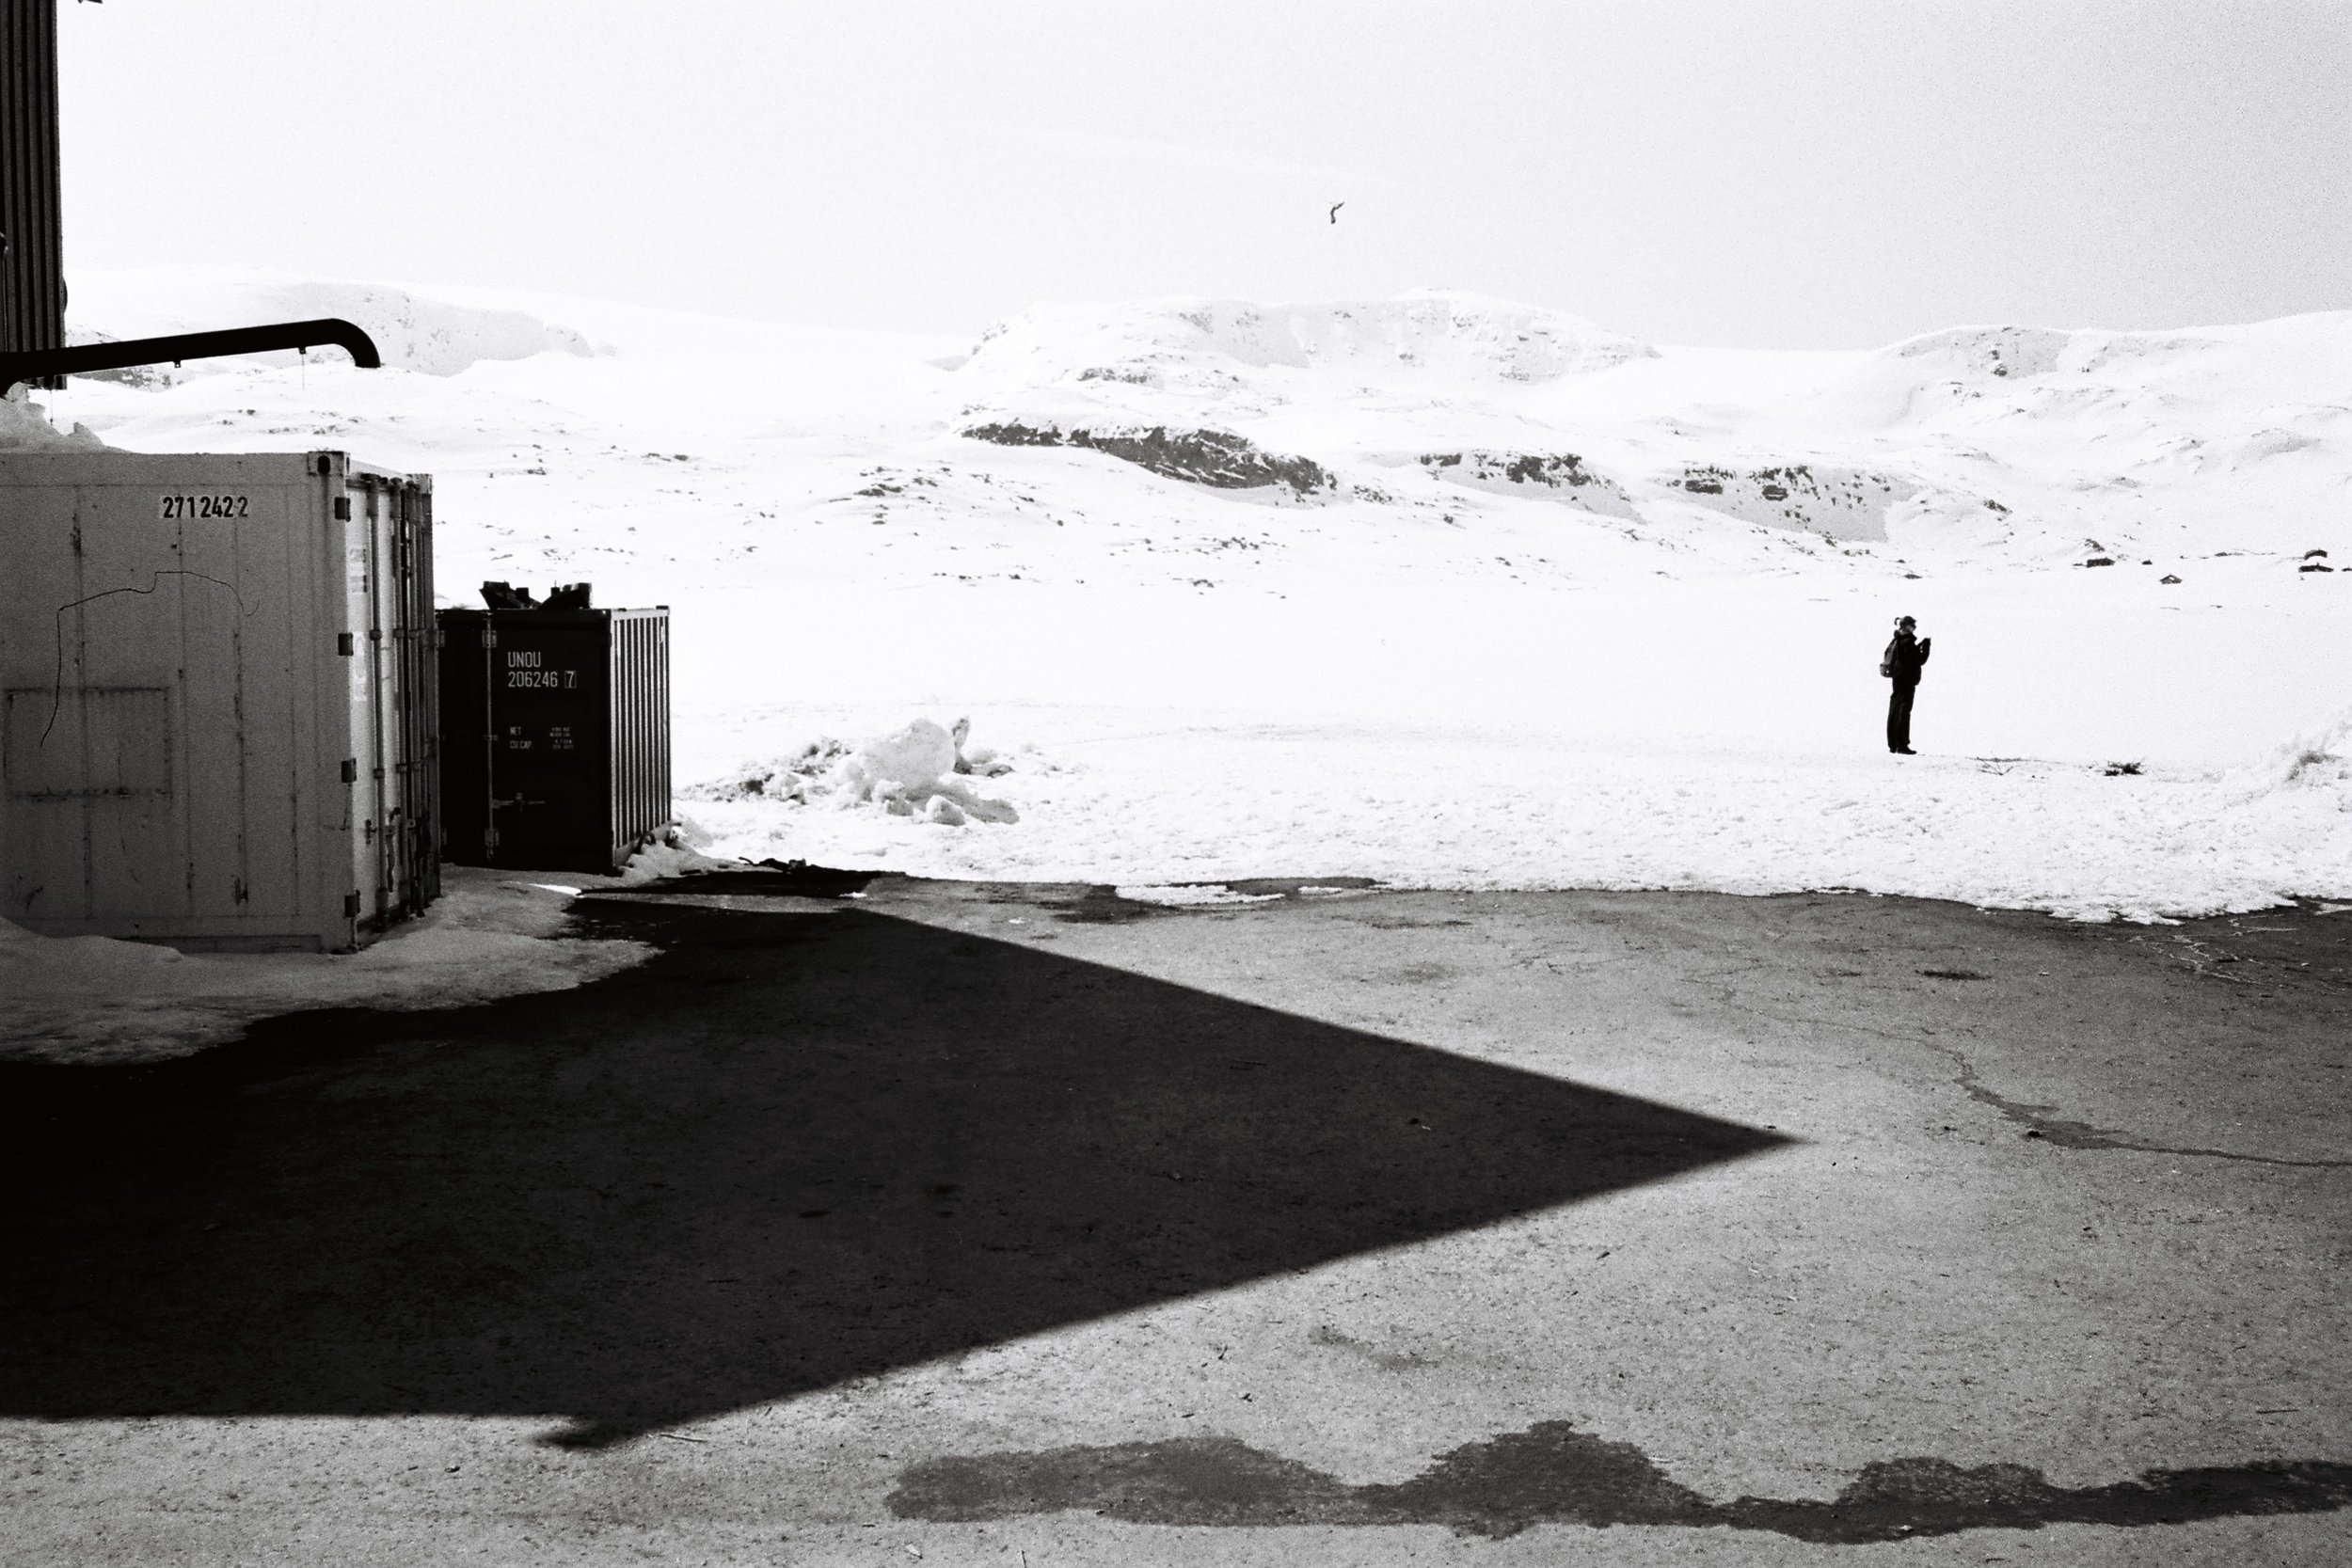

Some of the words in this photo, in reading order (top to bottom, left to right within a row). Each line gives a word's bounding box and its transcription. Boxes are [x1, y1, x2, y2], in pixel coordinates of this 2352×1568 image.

[507, 651, 542, 668] UNOU
[507, 671, 558, 688] 206246
[566, 670, 575, 689] 7
